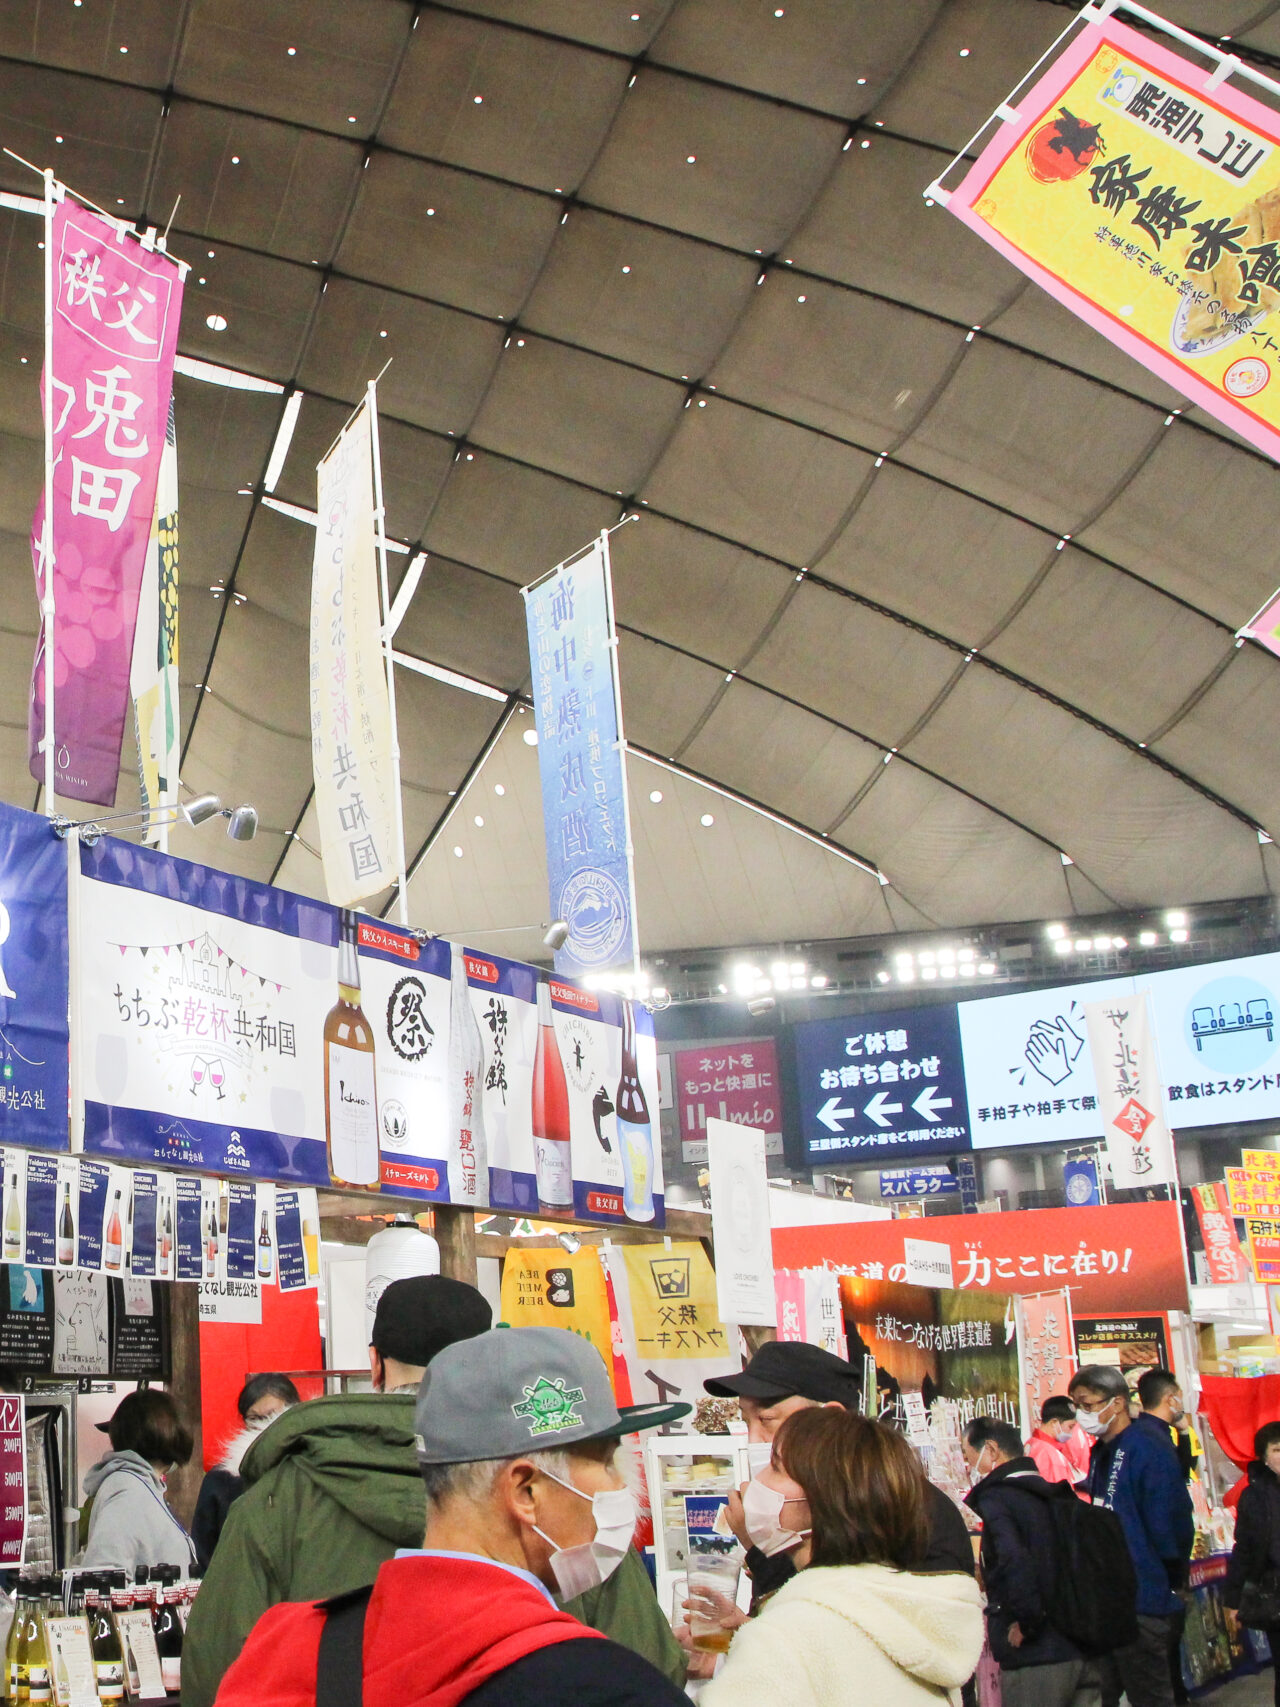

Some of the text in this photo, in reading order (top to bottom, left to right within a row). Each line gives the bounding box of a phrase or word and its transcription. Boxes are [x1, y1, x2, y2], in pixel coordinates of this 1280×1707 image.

[1124, 80, 1266, 180] 東海テレビ
[65, 247, 158, 345] 秩父
[1093, 224, 1280, 364] 将軍徳川家お膝元の名物八丁
[71, 364, 150, 533] 兎田
[362, 928, 412, 955] 秩父ウイスキー祭
[113, 982, 296, 1057] ちちぶ乾杯共和国
[482, 997, 508, 1107] 秩父錦
[845, 1028, 910, 1057] ご休憩
[699, 1053, 755, 1073] ネットを
[819, 1055, 941, 1091] お待ち合わせ
[684, 1072, 772, 1095] もっと快適に
[1168, 1074, 1280, 1102] 飲食はスタンド
[977, 1095, 1101, 1123] 手拍子や拍手で祭
[808, 1125, 967, 1153] 三塁側スタンド席をご利用ください
[385, 1166, 430, 1184] イチローズモルト
[881, 1179, 911, 1196] スパ
[1256, 1172, 1275, 1182] かに
[875, 1312, 993, 1352] 未来につなげる世界農業遺産
[24, 1376, 33, 1391] 2
[3, 1437, 22, 1453] 200円
[4, 1471, 23, 1488] 500円
